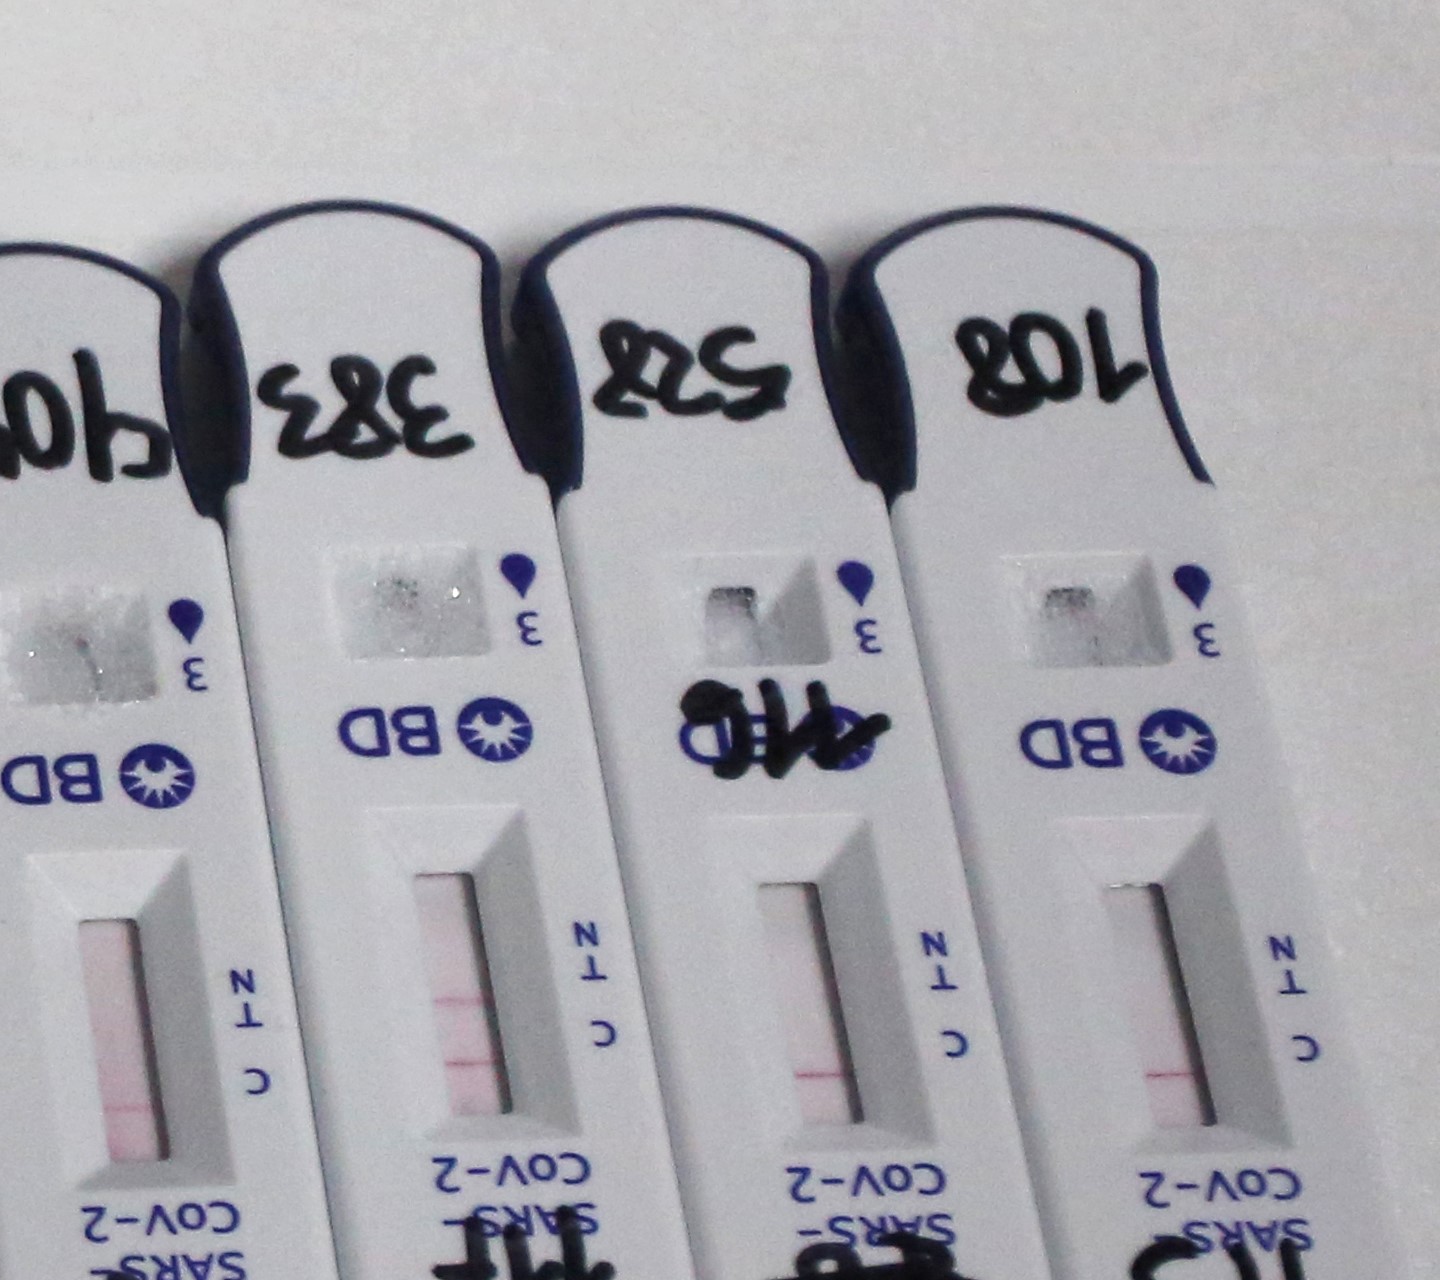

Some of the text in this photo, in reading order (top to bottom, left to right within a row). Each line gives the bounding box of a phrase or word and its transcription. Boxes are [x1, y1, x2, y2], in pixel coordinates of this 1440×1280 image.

[592, 320, 791, 422] 528
[954, 308, 1148, 417] 108
[256, 356, 474, 460] 383
[515, 609, 545, 647] 3
[853, 617, 882, 655] 3
[1192, 621, 1221, 658] 3
[181, 655, 207, 692] 3
[338, 704, 442, 758] BD
[1020, 717, 1125, 770] BD
[0, 752, 105, 806] BD
[574, 921, 600, 948] N
[920, 932, 949, 957] N
[1268, 936, 1297, 960] N
[230, 969, 257, 996] N
[581, 954, 609, 982] T
[931, 963, 958, 992] T
[1280, 969, 1309, 996] T
[236, 1002, 264, 1029] T
[591, 1019, 619, 1048] C
[943, 1029, 972, 1059] C
[1292, 1034, 1323, 1063] C
[244, 1066, 274, 1098] C
[431, 1151, 593, 1195] CoV-2
[786, 1161, 948, 1205] CoV-2
[1139, 1167, 1304, 1210] CoV-2
[80, 1200, 241, 1245] CoV-2
